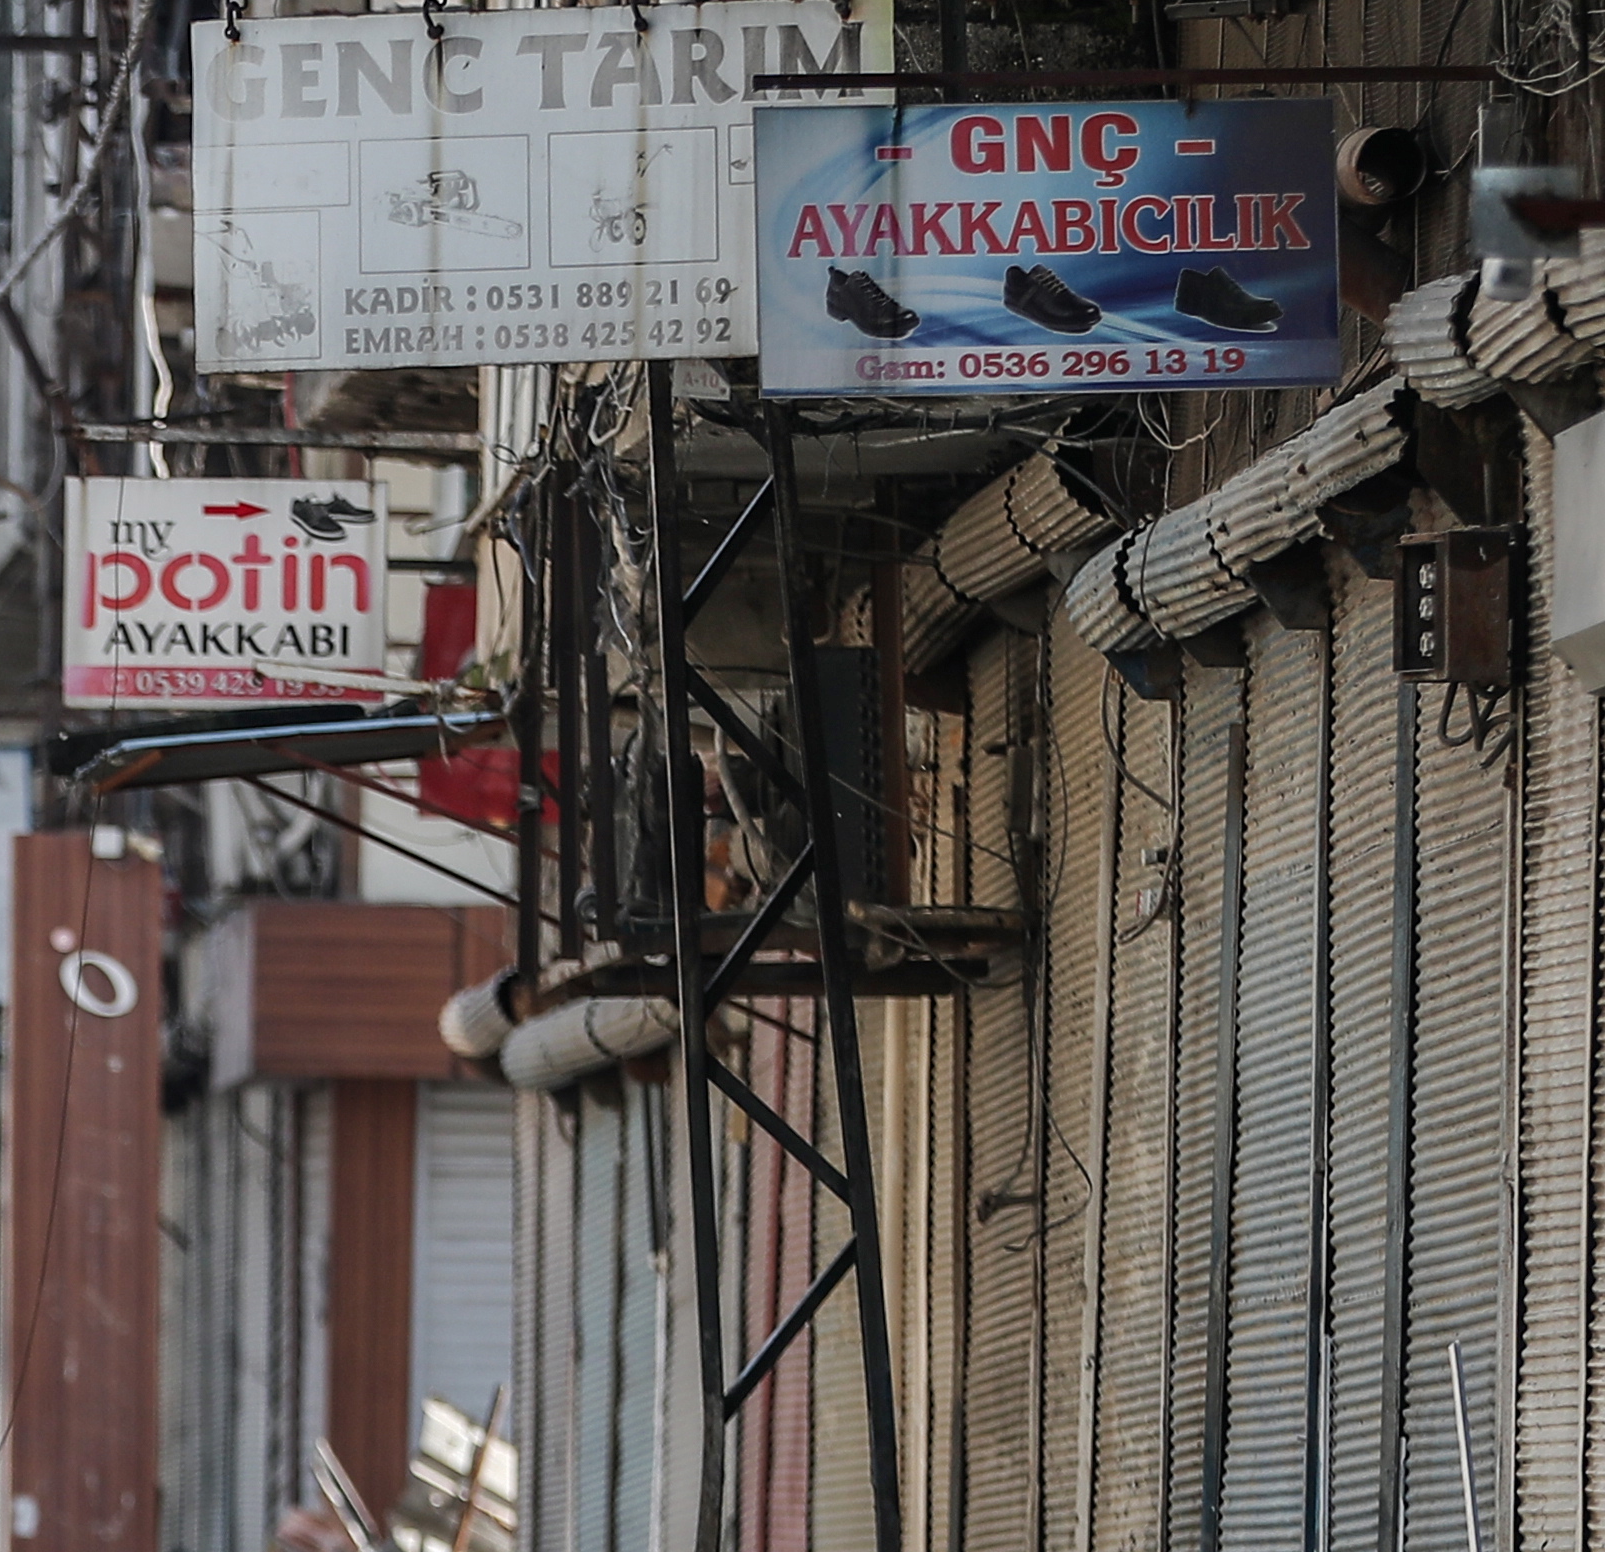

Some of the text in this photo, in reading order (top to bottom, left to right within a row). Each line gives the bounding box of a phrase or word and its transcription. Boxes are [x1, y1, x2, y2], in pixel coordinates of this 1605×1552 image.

[950, 112, 1140, 188] GNÇ
[787, 194, 1311, 258] AYAKKABICILIK
[486, 283, 560, 312] 0531
[576, 280, 632, 308] 889
[644, 279, 679, 306] 21
[695, 276, 731, 303] 69
[345, 325, 464, 354] EMRAH
[494, 323, 569, 350] 0538
[581, 320, 636, 348] 425
[648, 319, 684, 347] 42
[696, 316, 732, 343] 92
[854, 347, 1246, 381] Gsm: 0536 296 13 19
[110, 519, 175, 557] my
[81, 533, 370, 629] potin
[103, 621, 350, 658] AYAKKABI
[136, 671, 206, 694] 0539
